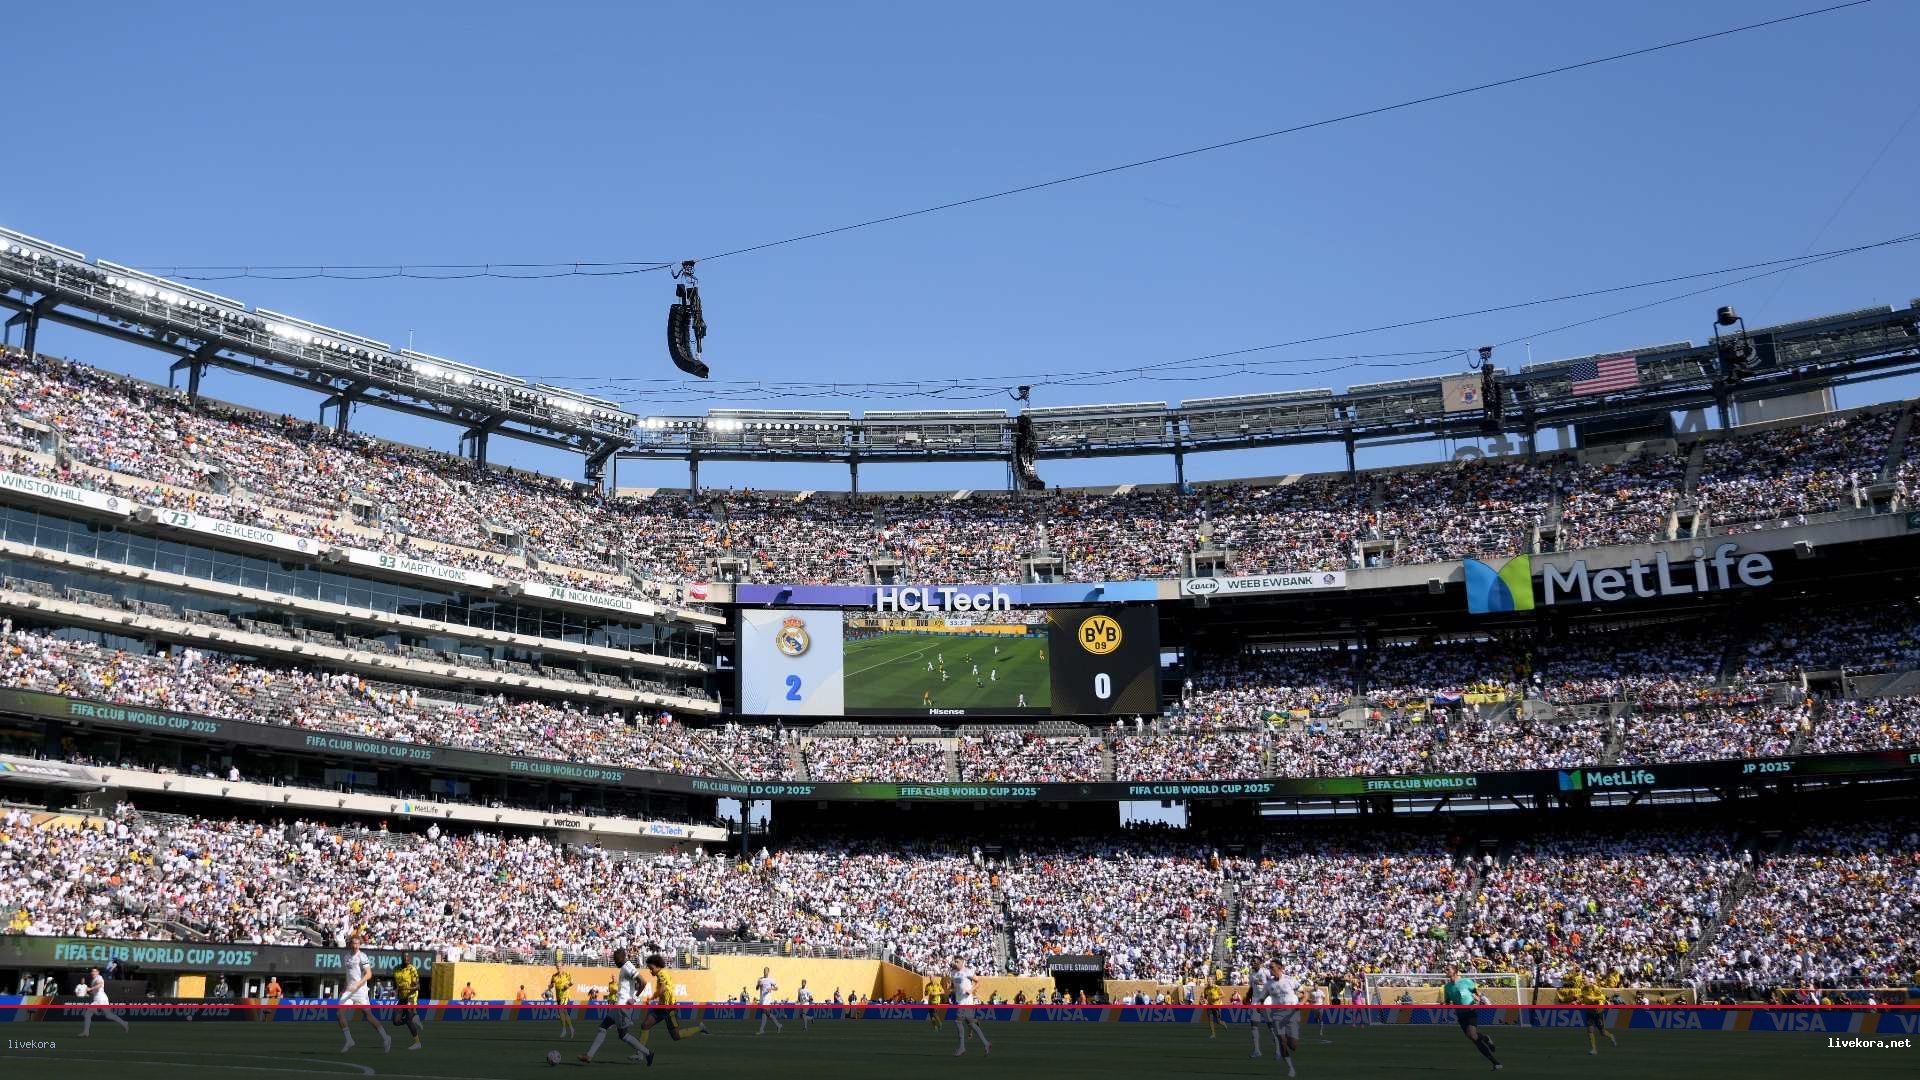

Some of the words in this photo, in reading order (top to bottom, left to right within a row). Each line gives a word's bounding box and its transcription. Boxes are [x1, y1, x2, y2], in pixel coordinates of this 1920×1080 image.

[1, 474, 58, 497] WINSTON
[60, 488, 85, 502] HILL
[170, 512, 189, 527] 73
[212, 522, 232, 535] JOE
[234, 526, 274, 543] KLECKO
[380, 555, 396, 568] 93
[400, 560, 437, 574] MARTY
[438, 568, 466, 581] LYONS
[1543, 542, 1774, 605] MetLife
[1190, 583, 1216, 591] COACH
[1227, 579, 1261, 589] WEEB
[1263, 576, 1313, 588] EWBANK
[550, 587, 565, 599] 74
[568, 591, 588, 603] NICK
[589, 594, 632, 610] MANGOLD
[876, 587, 1011, 612] HCLTech
[1085, 620, 1116, 642] BVB
[786, 675, 801, 700] 2
[1095, 673, 1111, 699] 0
[71, 703, 94, 716] FIFA
[97, 708, 125, 721] CLUB
[128, 711, 166, 727] WORLD
[168, 717, 189, 729] CUP
[306, 736, 327, 747] FIFA
[329, 739, 353, 751] CLUB
[354, 742, 388, 755] WORLD
[389, 746, 407, 758] CUP
[511, 760, 528, 771] FIFA
[530, 762, 552, 773] CLUB
[553, 765, 581, 777] WORLD
[583, 768, 600, 779] CUP
[1586, 769, 1655, 787] MetLife
[692, 780, 709, 790] FIFA
[710, 782, 729, 792] CLUB
[765, 785, 785, 794] CUP
[902, 787, 922, 796] FIFA
[924, 787, 950, 796] CLUB
[952, 787, 988, 796] WORLD
[990, 787, 1009, 796] CUP
[1129, 785, 1151, 795] FIFA
[1153, 785, 1180, 794] CLUB
[1182, 784, 1219, 794] WORLD
[1221, 783, 1242, 793] CUP
[1368, 780, 1391, 790] FIFA
[1393, 779, 1421, 789] CLUB
[1423, 777, 1463, 788] WORLD
[554, 818, 580, 828] verizon
[650, 824, 683, 835] HCLTech
[54, 943, 88, 961] FIFA
[132, 946, 184, 964] WORLD
[187, 949, 215, 965] CUP
[315, 953, 342, 969] FIFA
[288, 1000, 329, 1020] VISA
[455, 1000, 490, 1020] VISA
[879, 1008, 912, 1019] VISA
[1046, 1008, 1084, 1021] VISA
[1136, 1008, 1176, 1022] VISA
[1533, 1009, 1584, 1027] VISA
[1645, 1010, 1702, 1029] VISA
[1766, 1012, 1827, 1032] VISA
